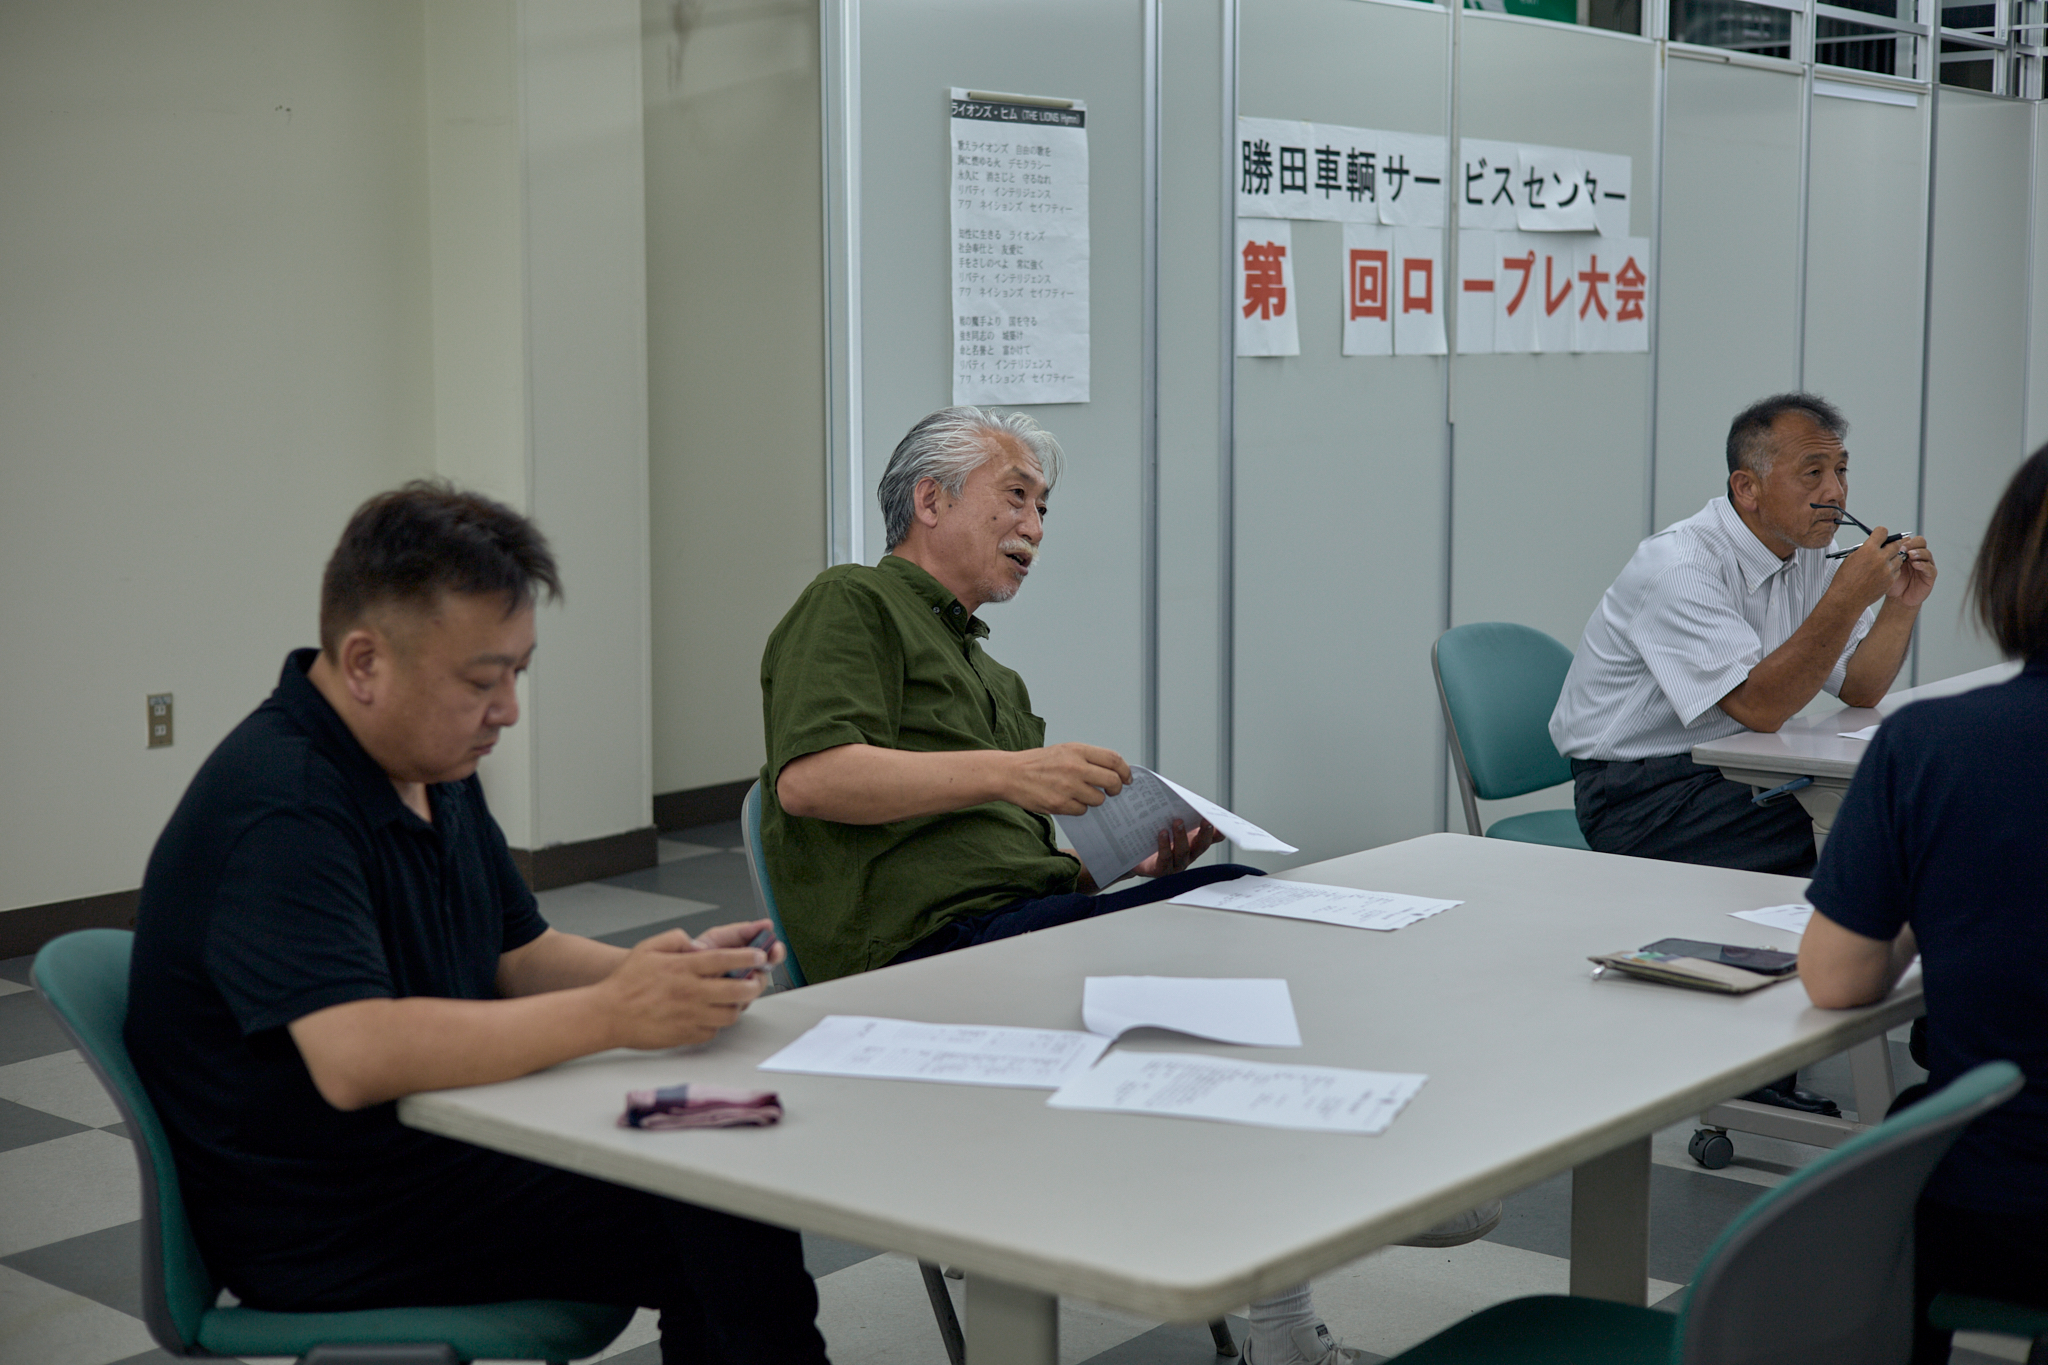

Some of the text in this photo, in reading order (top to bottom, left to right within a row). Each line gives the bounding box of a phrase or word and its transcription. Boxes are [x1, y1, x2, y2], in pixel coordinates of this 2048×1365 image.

[1008, 159, 1051, 170] デモクラシー
[1009, 231, 1045, 241] ライオンズ
[1242, 240, 1646, 322] 第 回ロープレ大会
